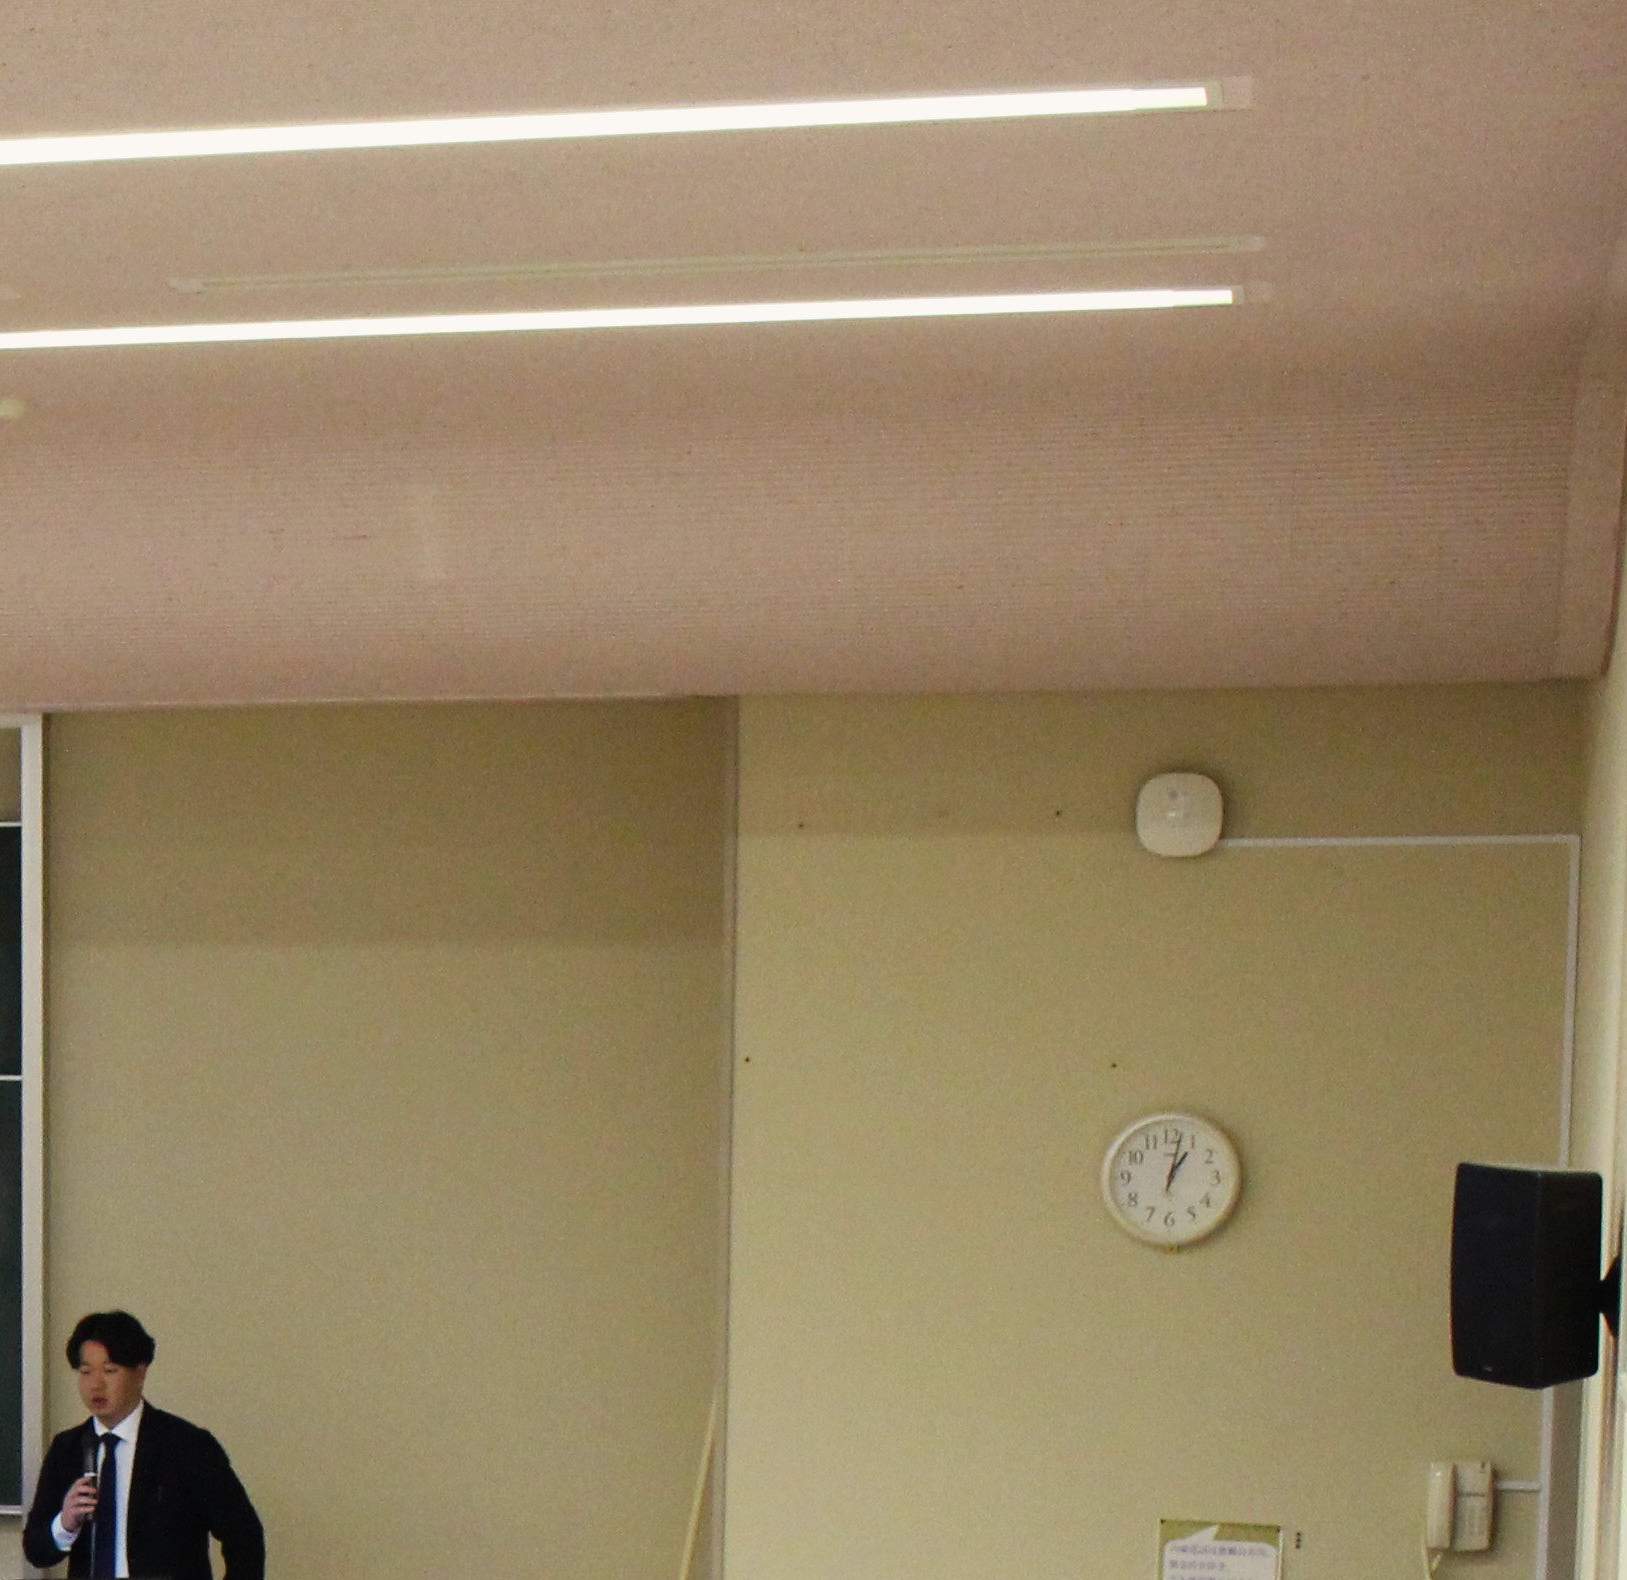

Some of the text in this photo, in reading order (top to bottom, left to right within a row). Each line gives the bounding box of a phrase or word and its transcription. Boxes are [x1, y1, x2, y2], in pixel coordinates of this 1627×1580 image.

[1144, 1134, 1157, 1150] 11
[1128, 1150, 1144, 1165] 10
[1204, 1149, 1214, 1164] 2
[1120, 1170, 1132, 1186] 9
[1210, 1169, 1221, 1186] 3
[1128, 1192, 1138, 1208] 8
[1199, 1192, 1210, 1208] 4
[1146, 1206, 1155, 1222] 7
[1164, 1211, 1175, 1227] 6
[1187, 1205, 1196, 1221] 5
